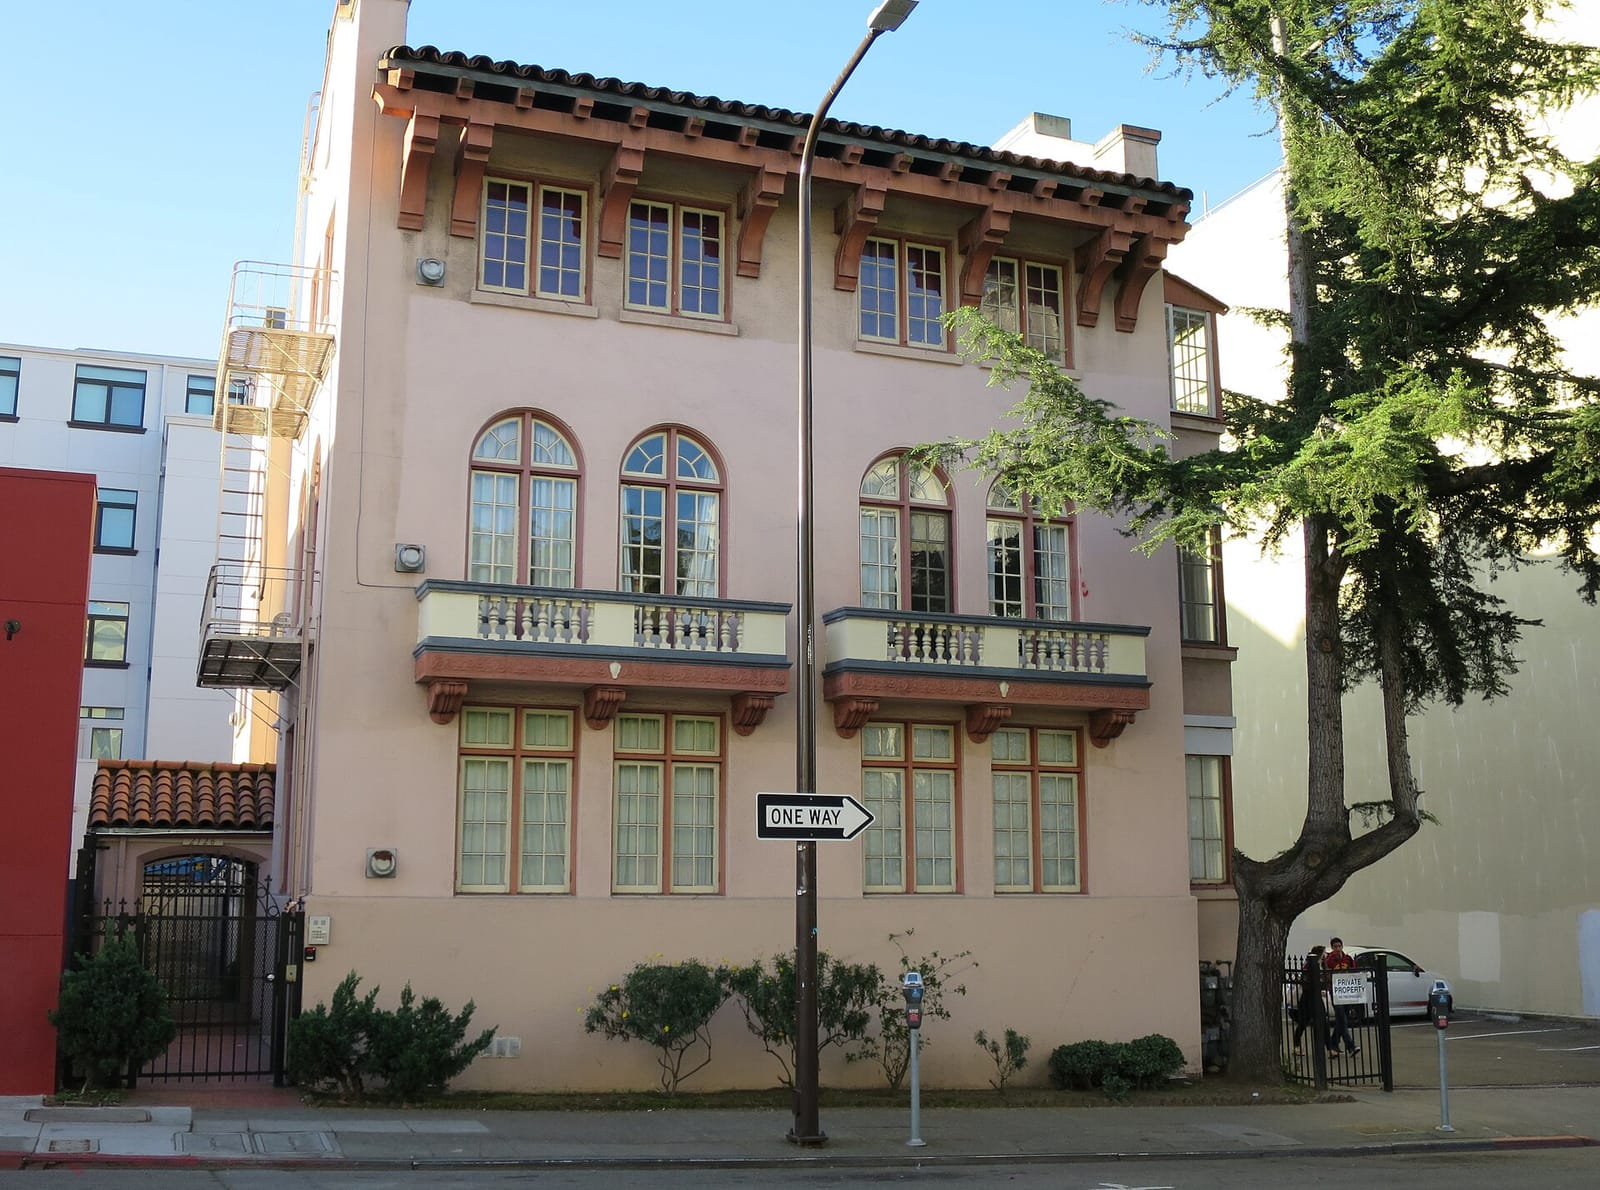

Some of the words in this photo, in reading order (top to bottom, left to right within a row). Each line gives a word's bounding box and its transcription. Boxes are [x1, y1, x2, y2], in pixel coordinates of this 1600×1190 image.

[771, 808, 803, 825] ONE
[809, 809, 841, 825] WAY
[1337, 978, 1361, 986] PRIVATE
